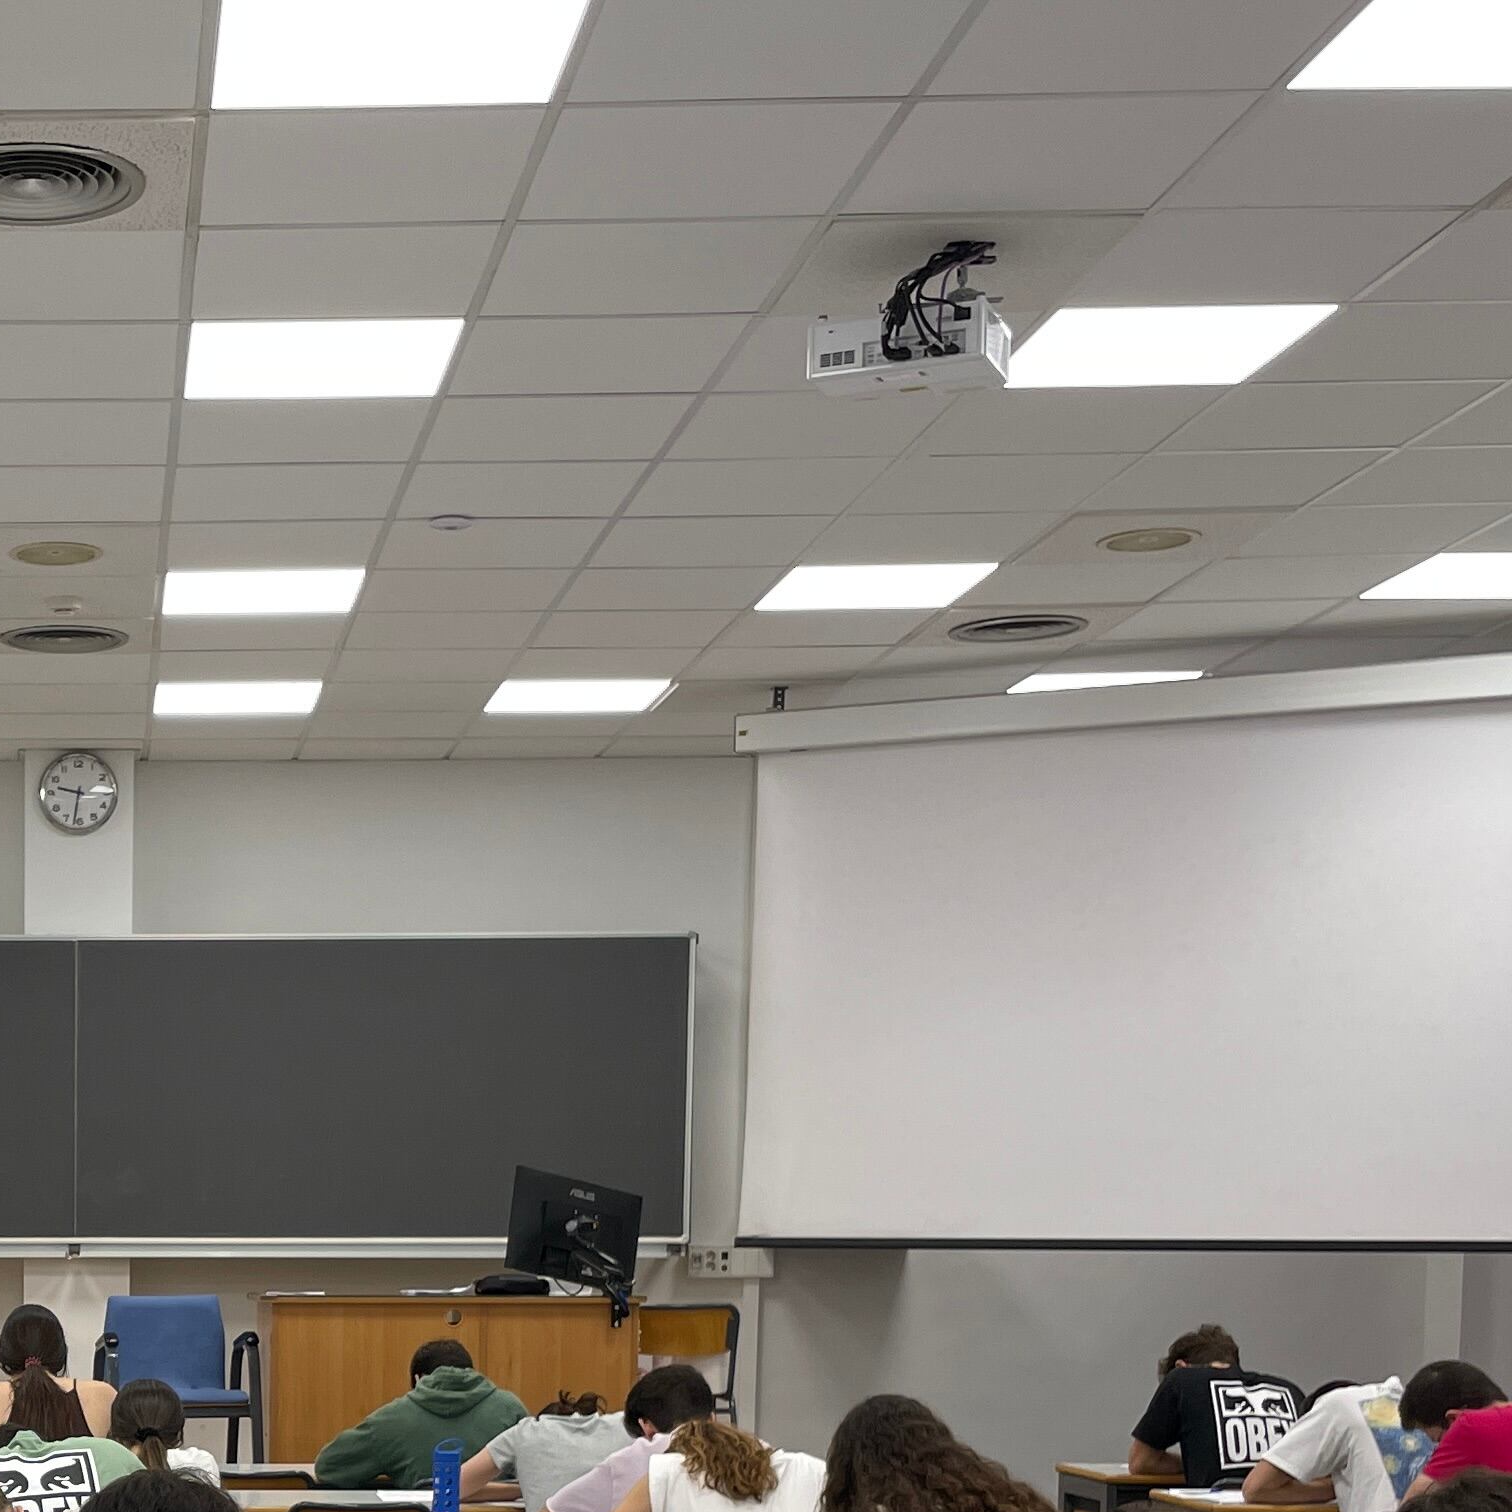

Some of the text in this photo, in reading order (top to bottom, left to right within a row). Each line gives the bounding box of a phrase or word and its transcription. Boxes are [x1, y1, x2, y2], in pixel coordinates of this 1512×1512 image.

[73, 760, 84, 768] 12
[52, 804, 60, 812] 8
[62, 814, 69, 822] 7
[76, 817, 84, 825] 6
[90, 813, 98, 821] 5
